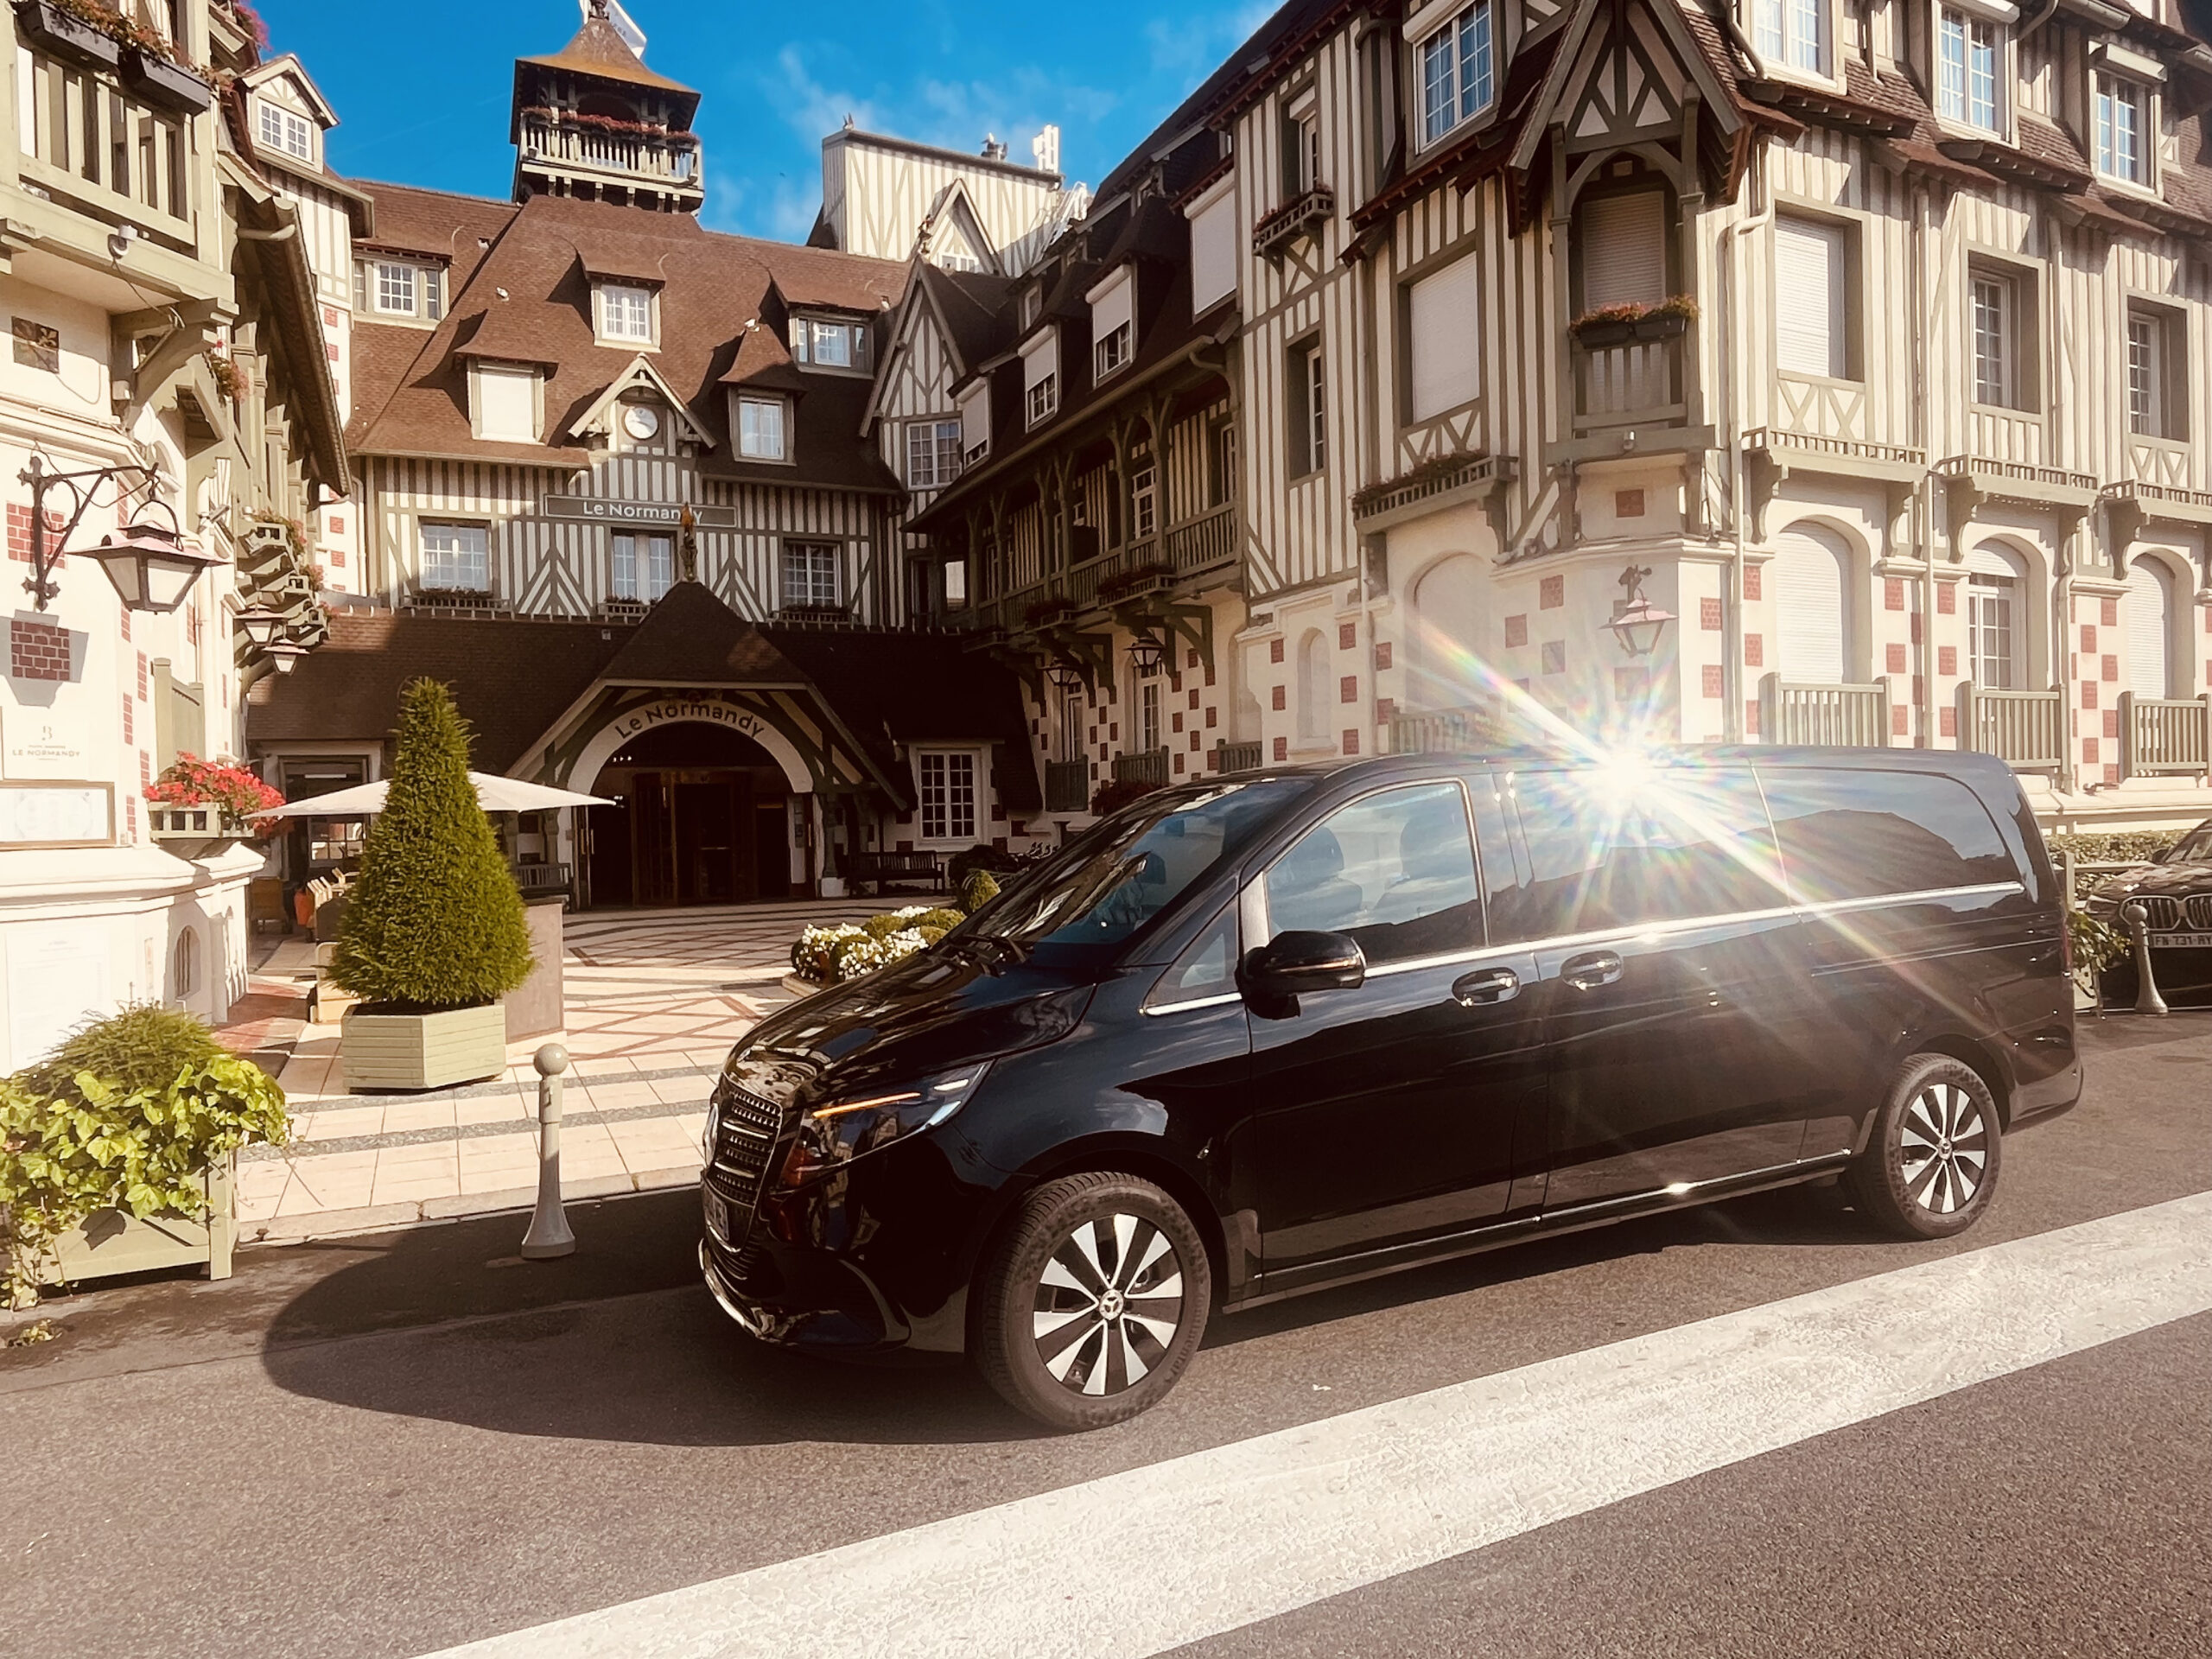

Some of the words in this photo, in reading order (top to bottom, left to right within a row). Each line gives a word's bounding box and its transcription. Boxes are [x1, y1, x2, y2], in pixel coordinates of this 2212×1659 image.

[583, 501, 604, 516] Le
[609, 503, 702, 525] Normany
[614, 718, 644, 739] Le
[645, 702, 765, 739] Normandy
